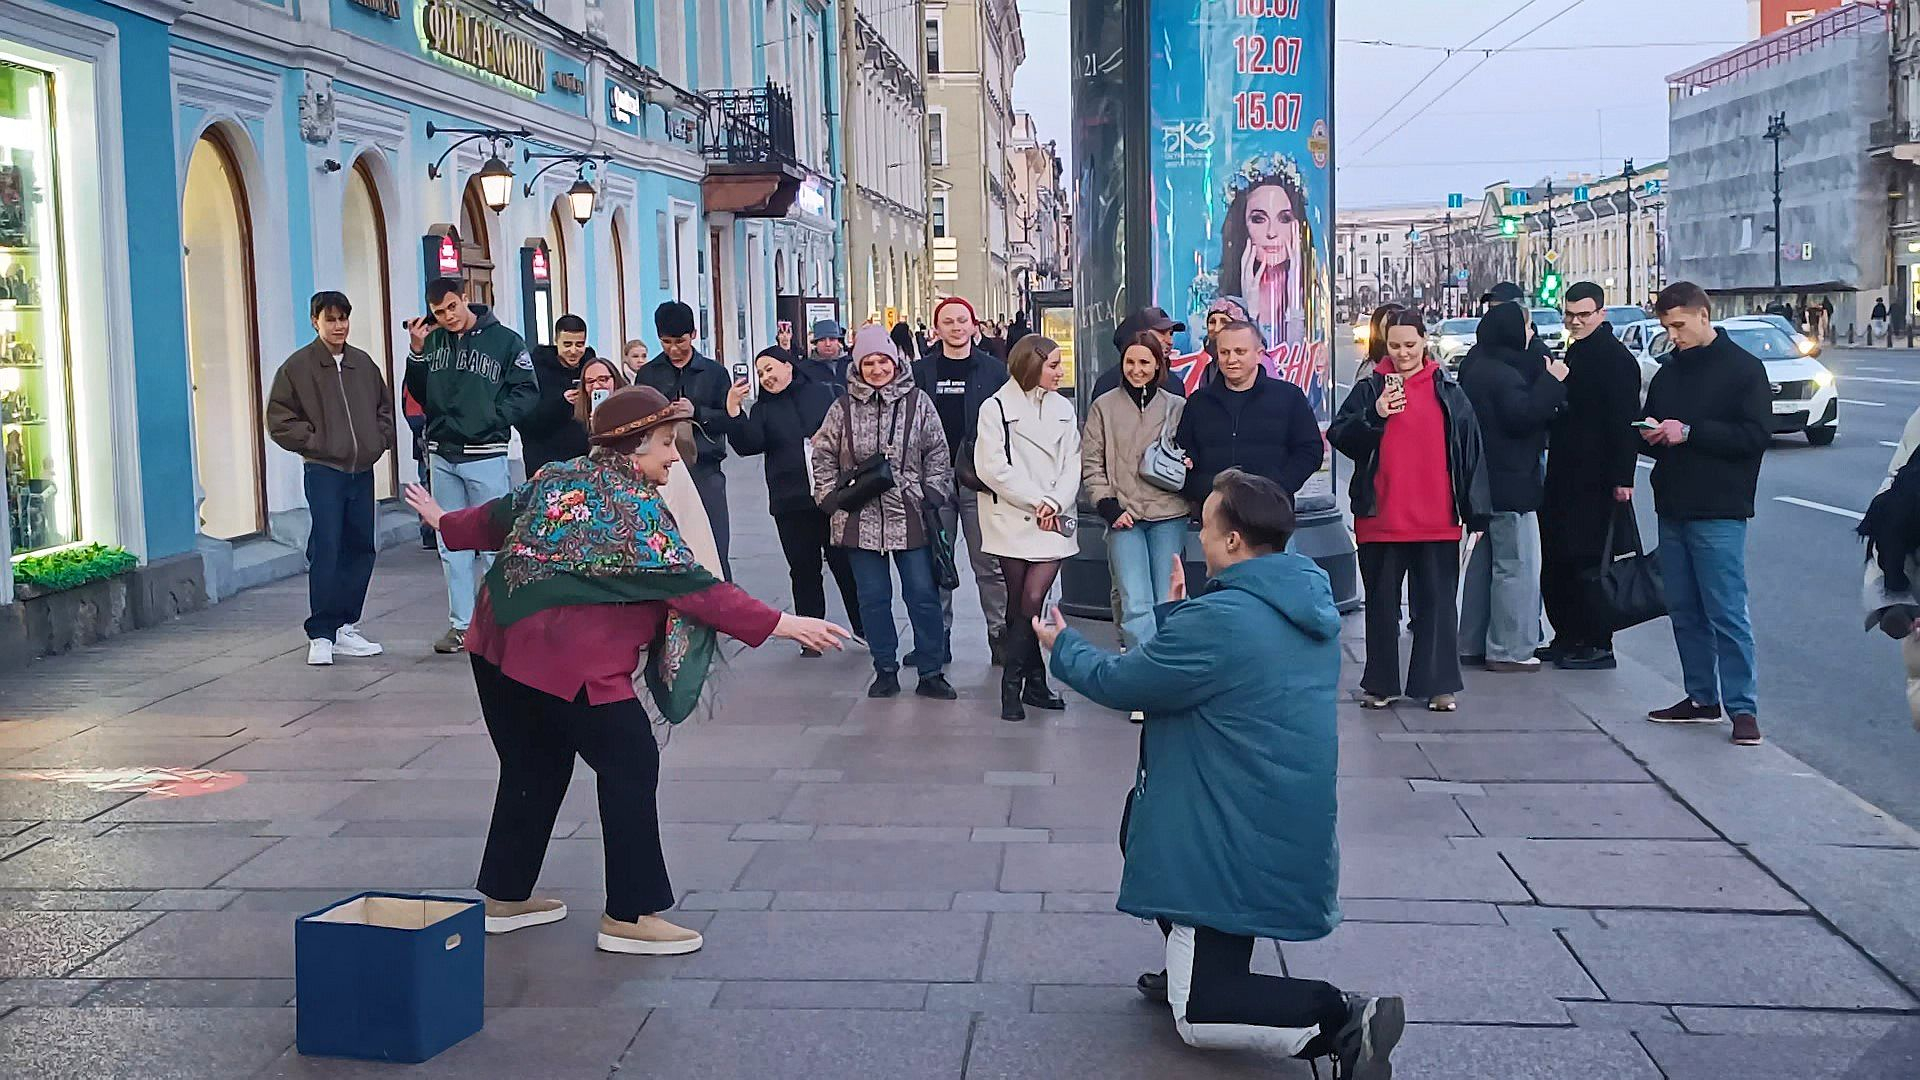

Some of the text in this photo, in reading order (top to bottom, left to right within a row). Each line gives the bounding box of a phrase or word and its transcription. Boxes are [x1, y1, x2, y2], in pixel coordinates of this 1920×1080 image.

[428, 2, 546, 93] ФИЛАРМОНИЯ
[1233, 35, 1302, 76] 12.07
[1233, 91, 1302, 131] 15.07
[1161, 121, 1216, 164] БКЗ
